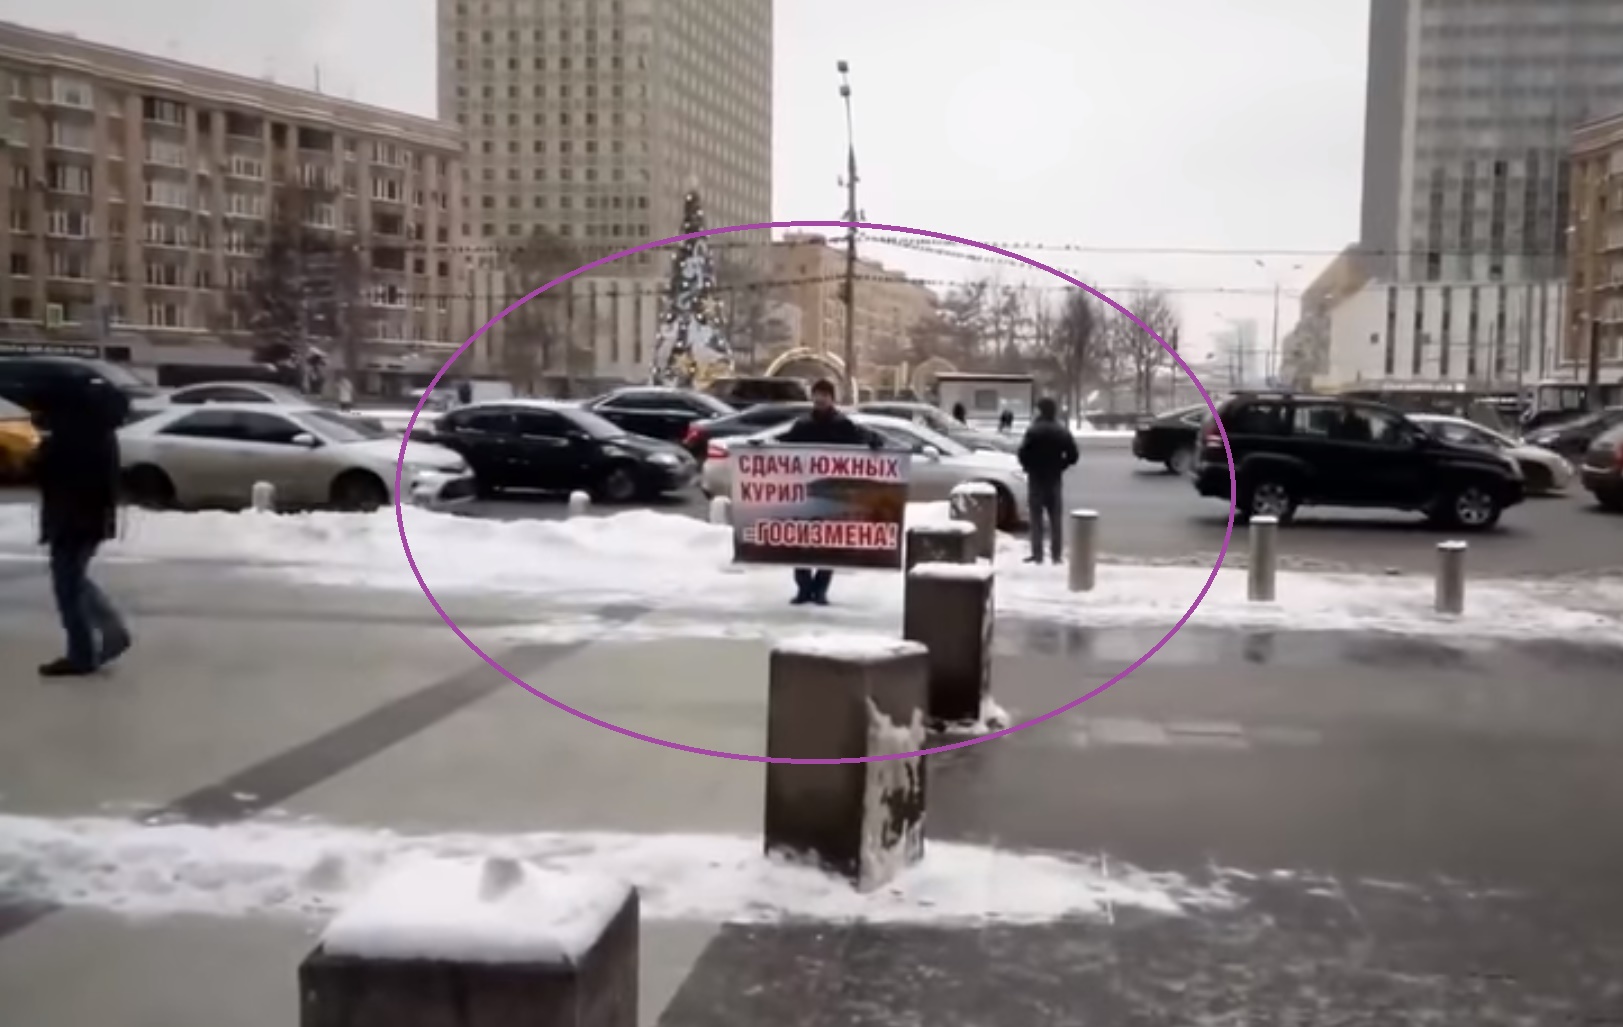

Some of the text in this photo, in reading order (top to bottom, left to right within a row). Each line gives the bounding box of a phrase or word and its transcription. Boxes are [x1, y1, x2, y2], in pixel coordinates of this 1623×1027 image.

[739, 455, 898, 477] СДАЧА ЮЖНЫХ
[741, 482, 805, 502] КУРИЛ
